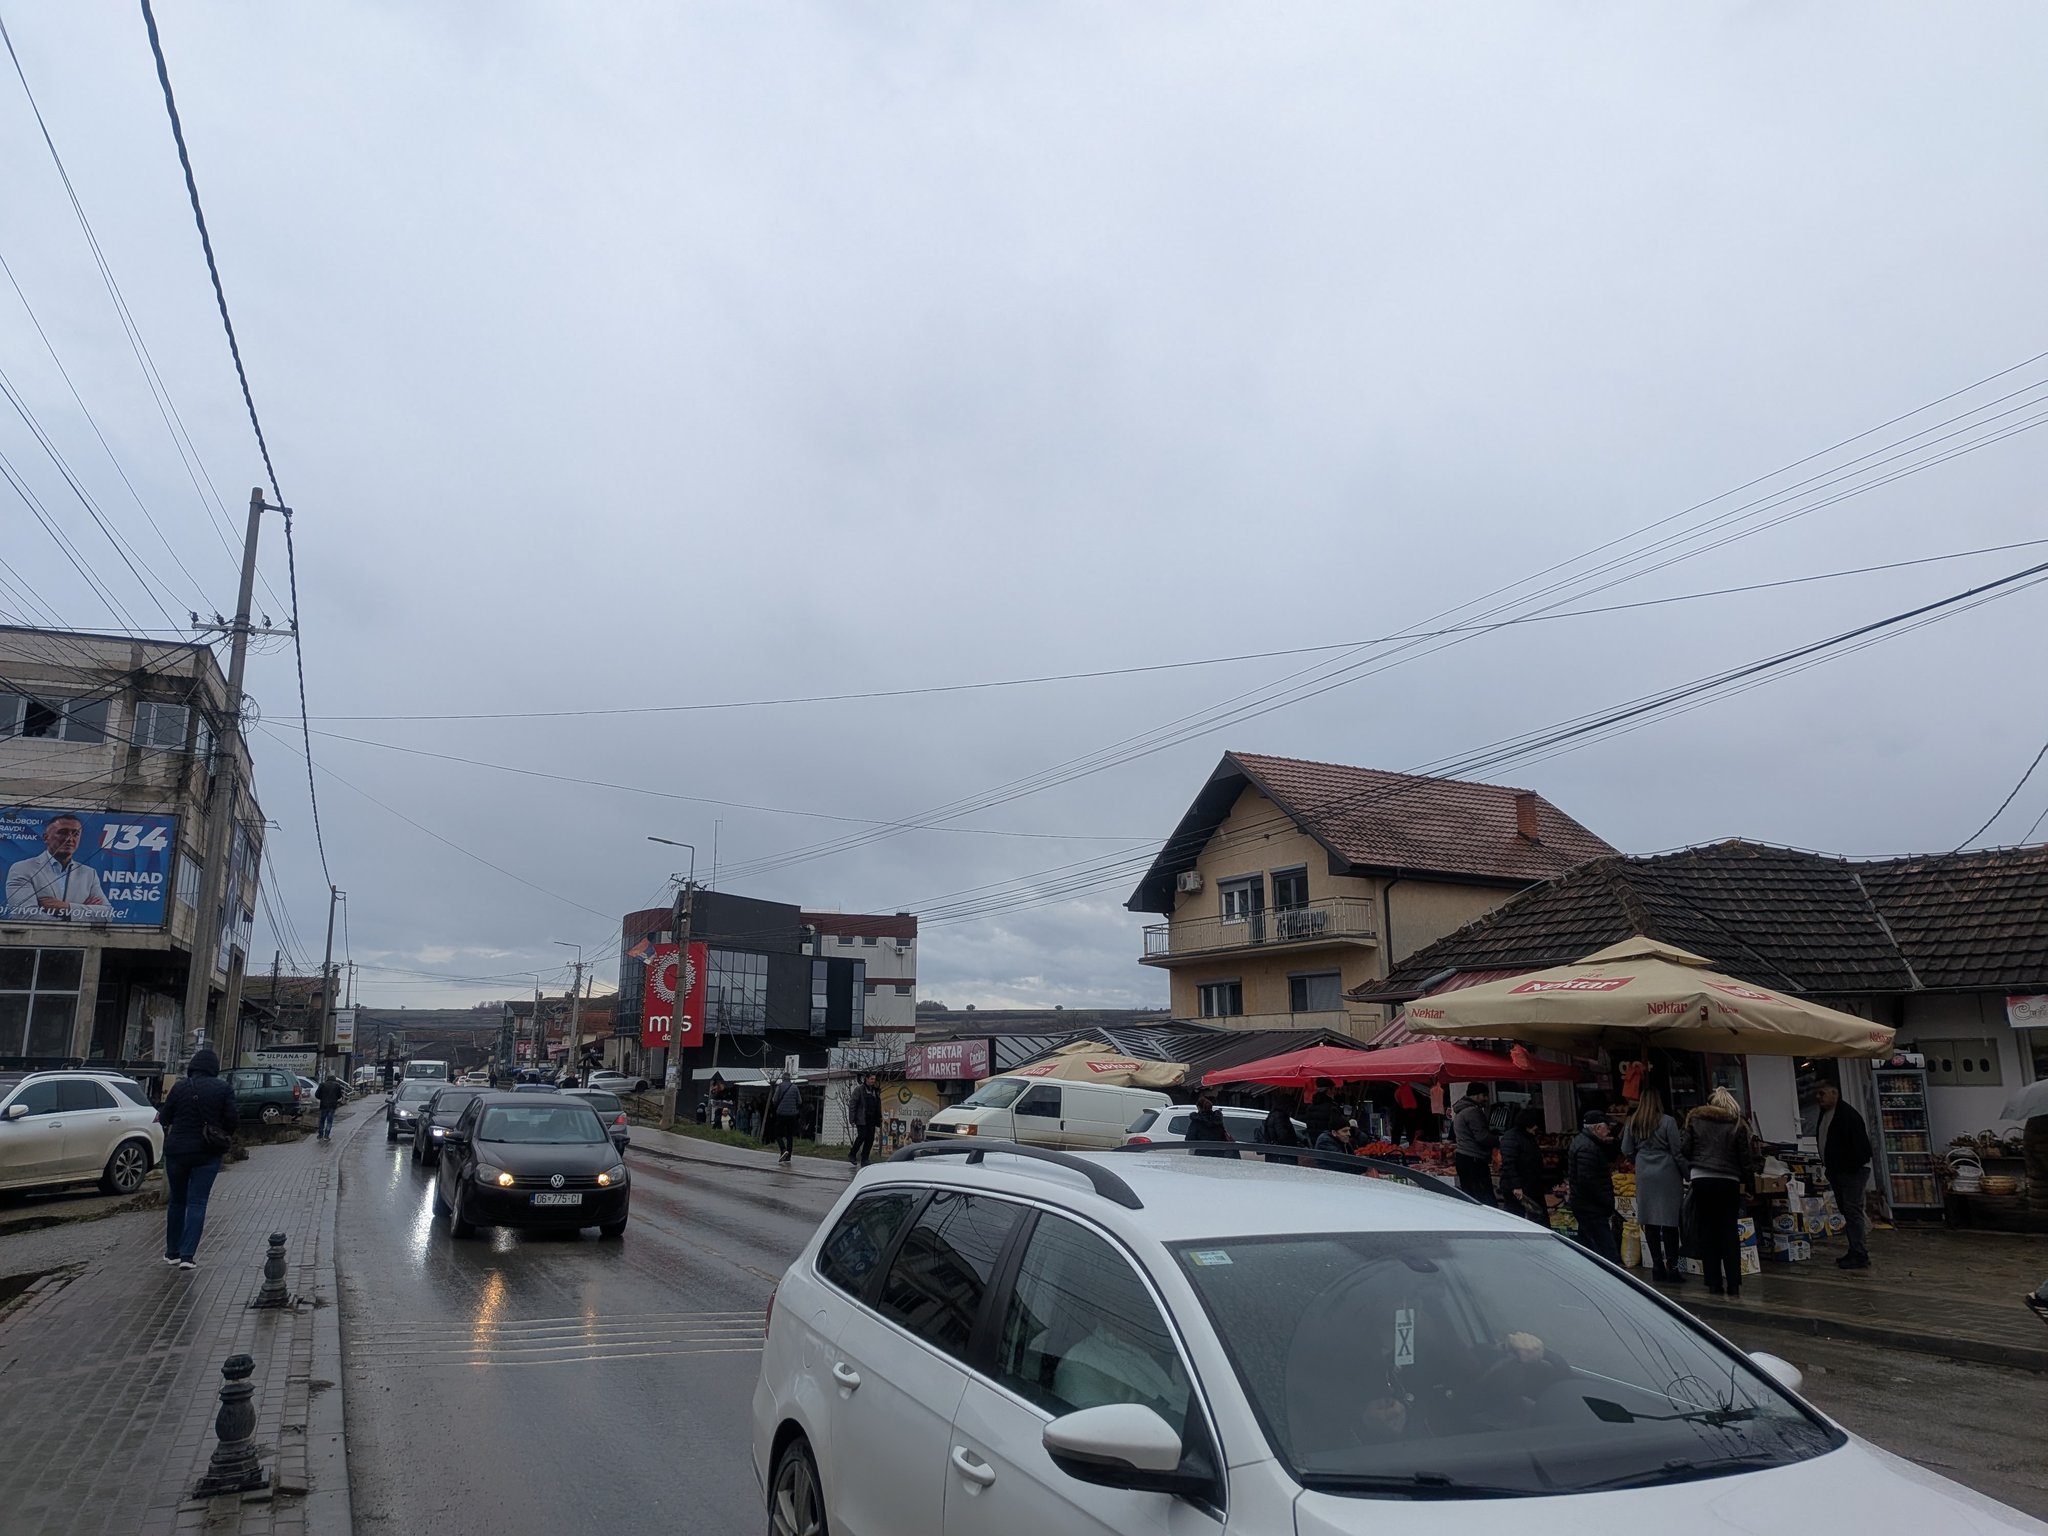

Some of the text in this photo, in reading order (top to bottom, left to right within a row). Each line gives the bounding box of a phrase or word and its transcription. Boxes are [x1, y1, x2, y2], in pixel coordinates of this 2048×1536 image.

[101, 823, 168, 851] 134
[103, 870, 163, 884] NENAD
[109, 886, 161, 902] RAŠIĆ
[47, 908, 56, 916] u
[58, 907, 94, 919] svoje
[95, 907, 129, 919] ruke!
[1523, 979, 1620, 992] Nektar
[1411, 1008, 1445, 1019] Nektar
[1647, 1002, 1688, 1015] Nektar
[649, 1015, 692, 1032] ms
[927, 1045, 963, 1059] SPEKTAR
[929, 1062, 961, 1076] MARKET
